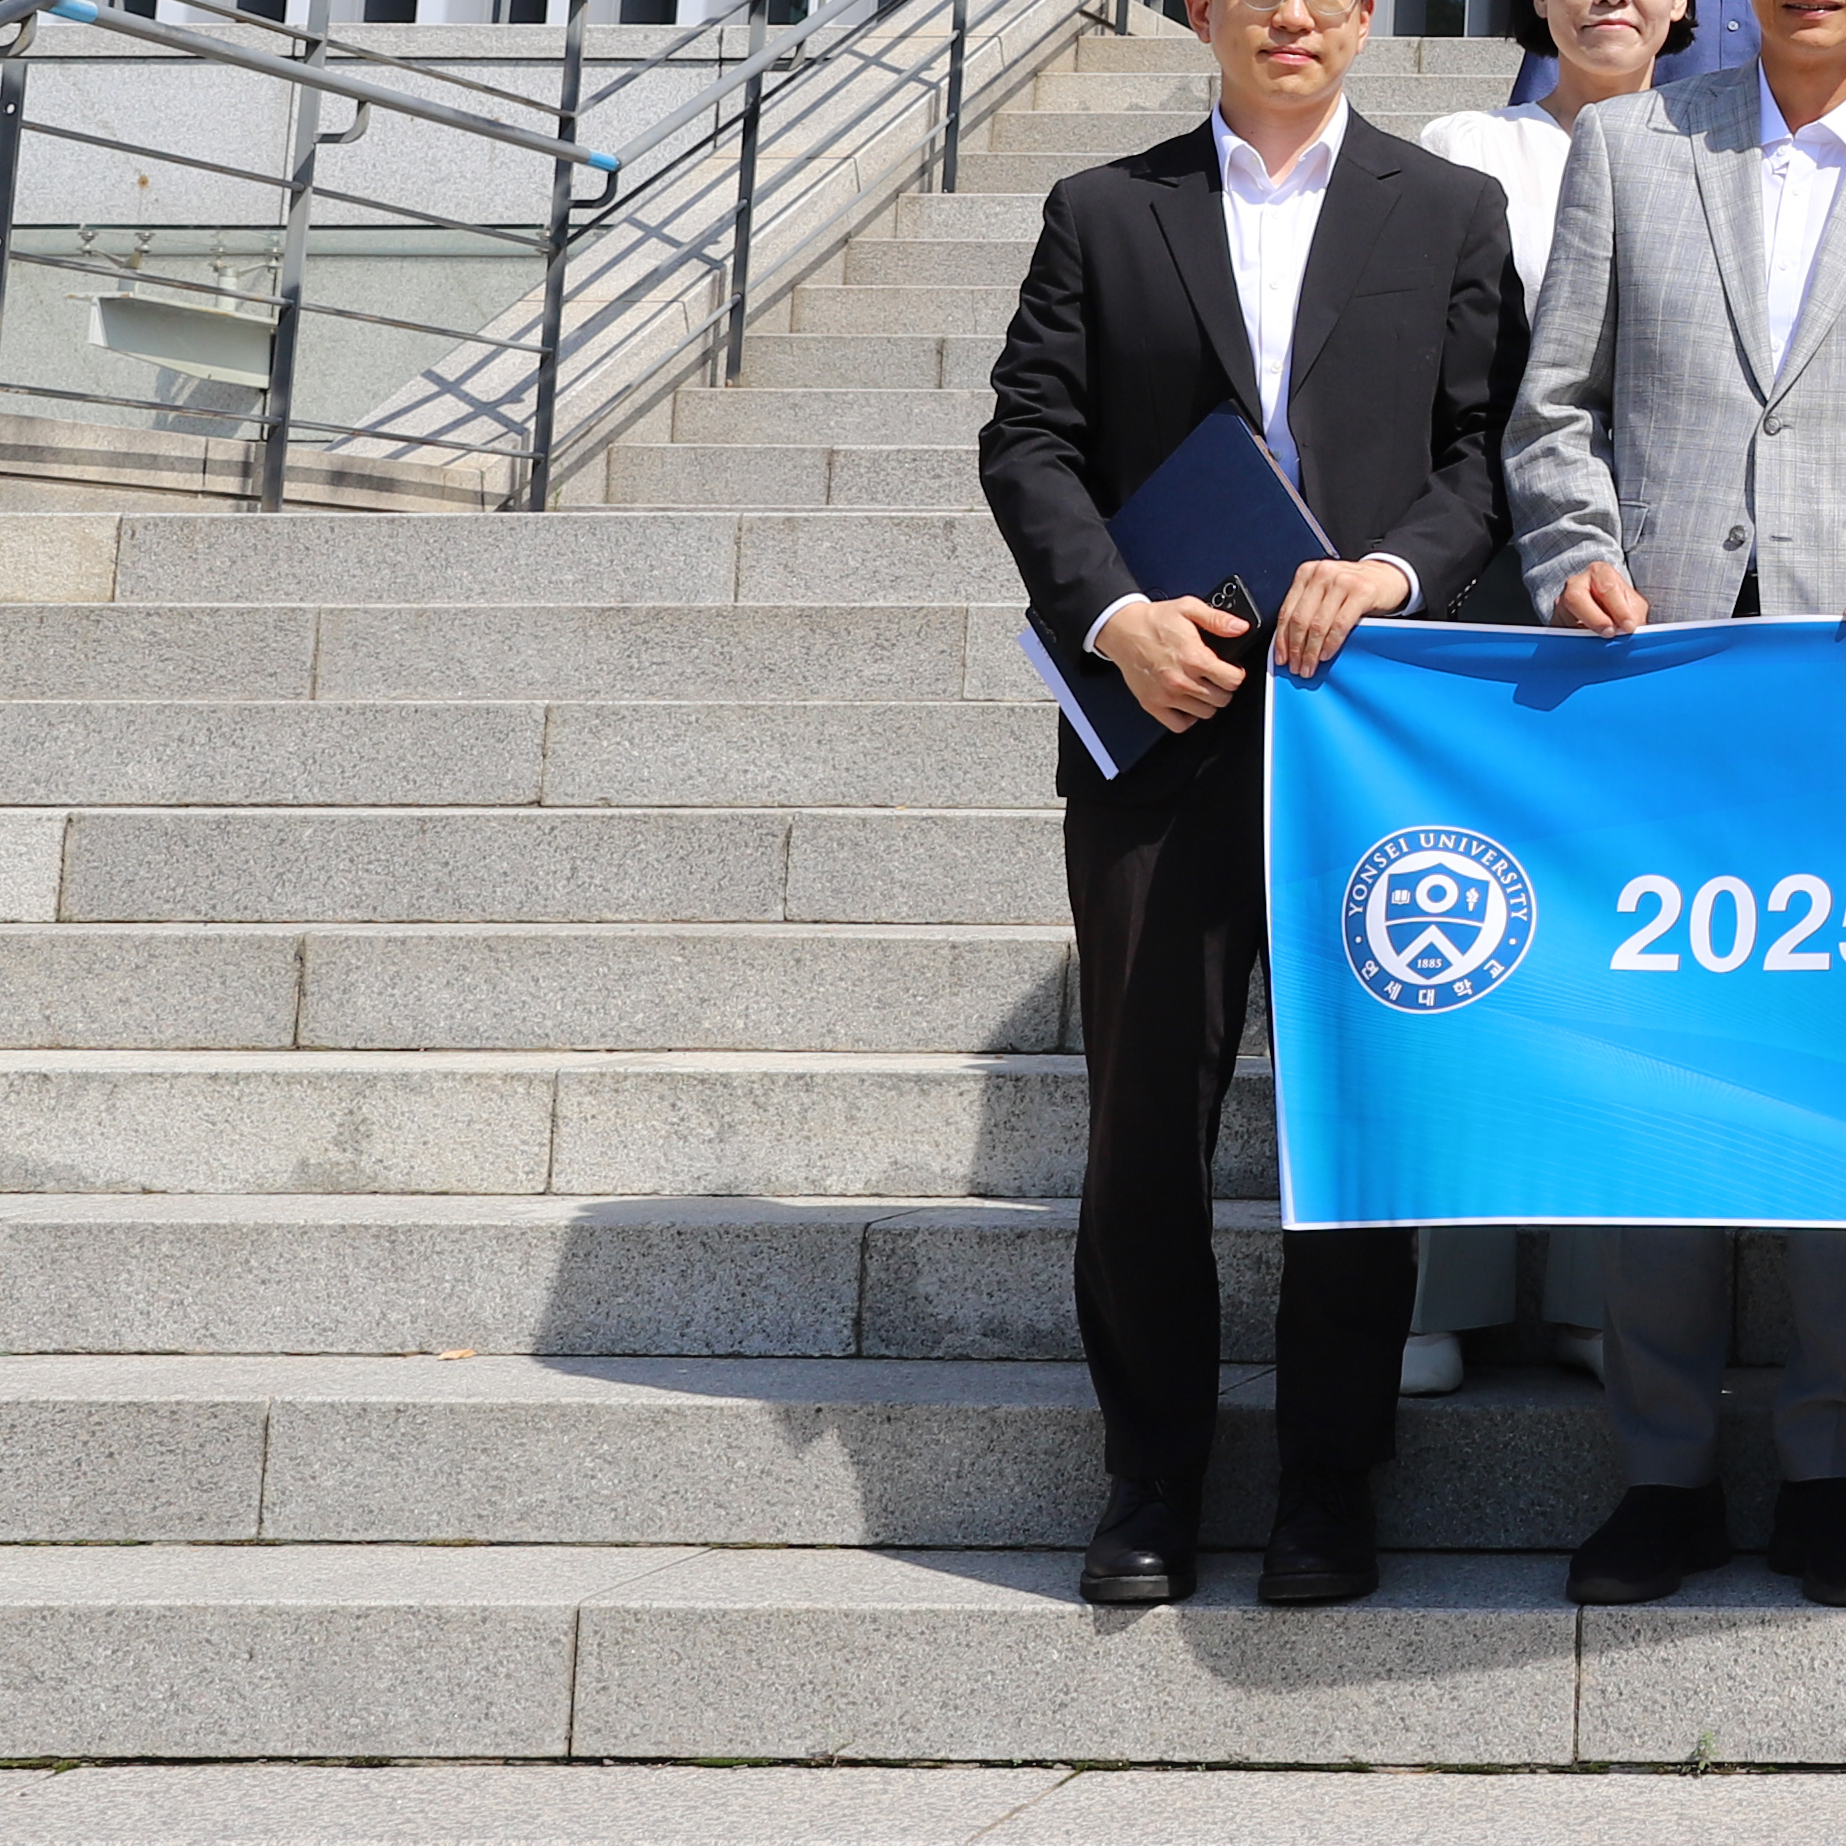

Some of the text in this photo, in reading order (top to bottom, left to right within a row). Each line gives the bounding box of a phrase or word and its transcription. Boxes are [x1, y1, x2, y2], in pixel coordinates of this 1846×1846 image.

[1348, 833, 1528, 922] YONSEI UNIVERSITY
[1361, 959, 1505, 1006] 연세대학교
[1416, 958, 1443, 969] 1885
